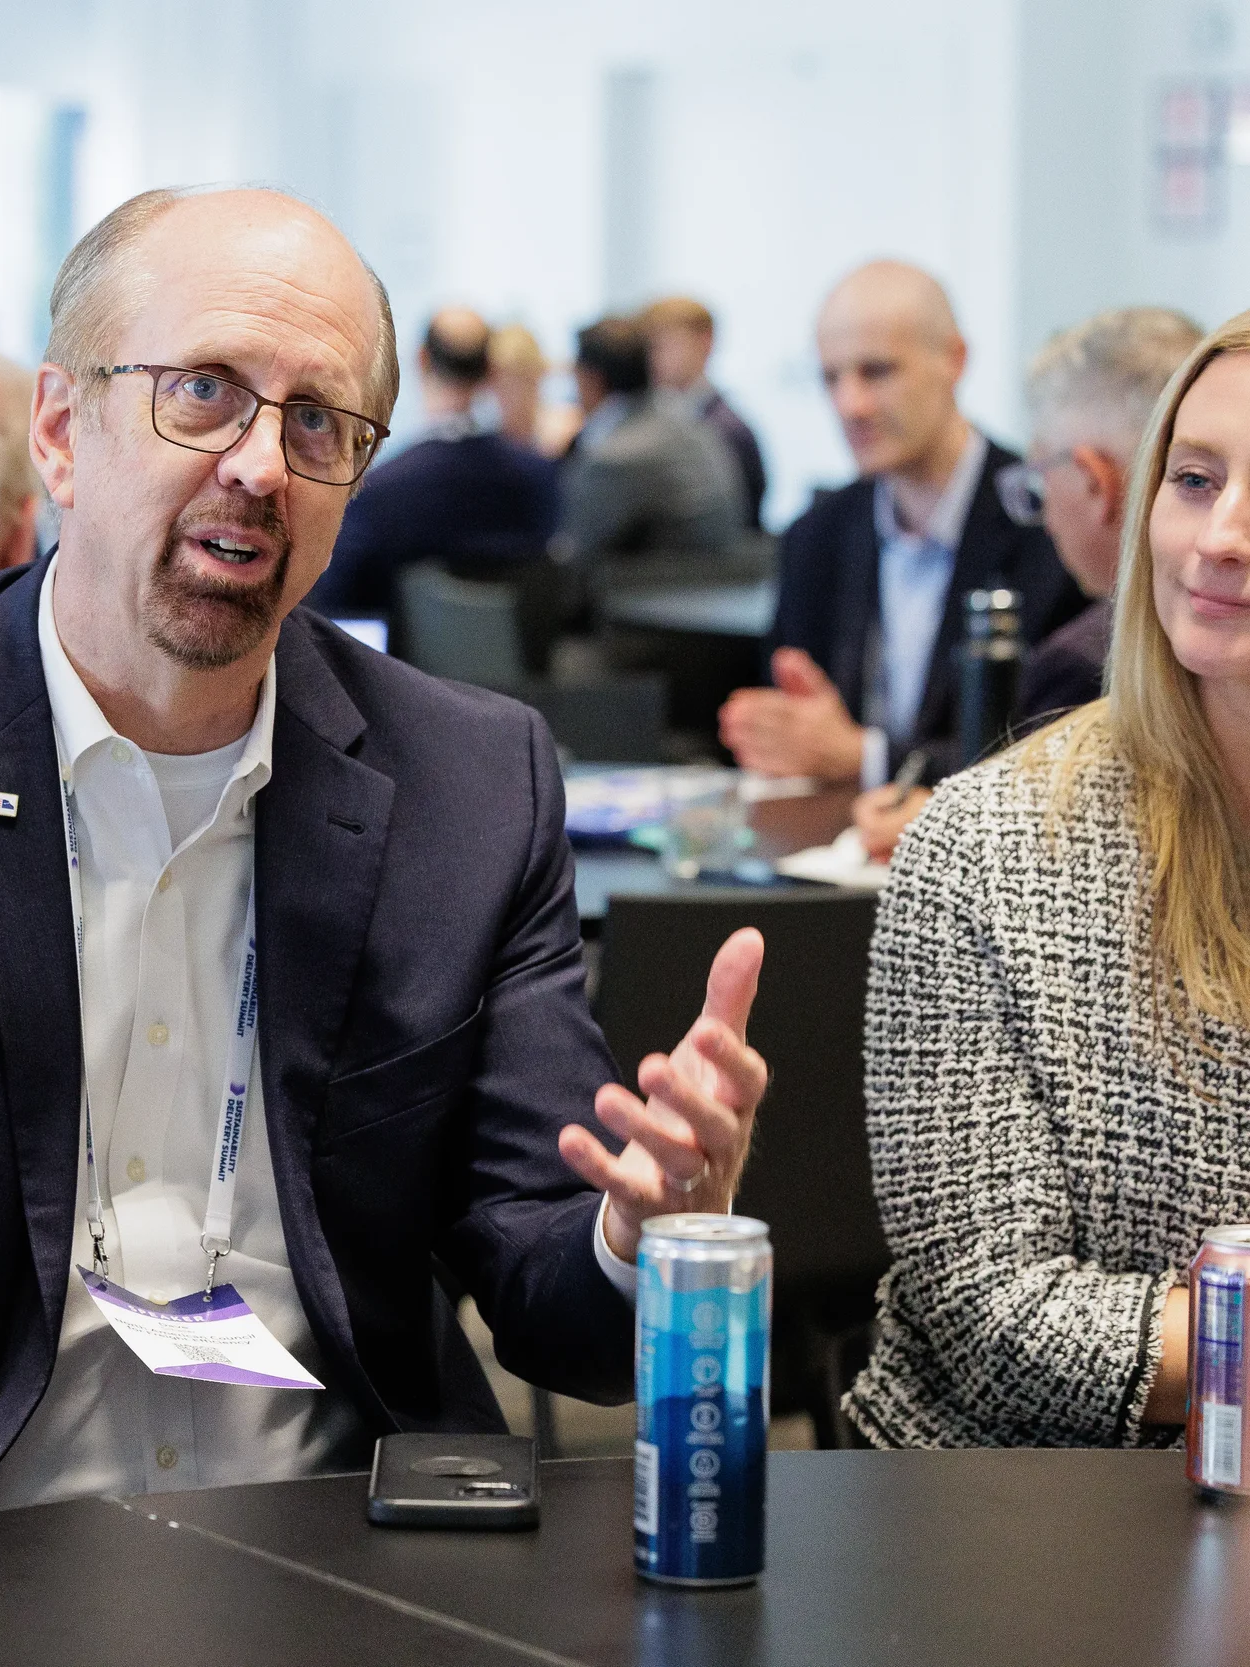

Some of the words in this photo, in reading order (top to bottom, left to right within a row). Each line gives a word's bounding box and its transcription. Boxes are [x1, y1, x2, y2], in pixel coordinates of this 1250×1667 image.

[242, 953, 254, 1000] DELIVERY
[237, 1000, 248, 1037] SUMMIT
[223, 1098, 235, 1144] DELIVERY
[228, 1100, 243, 1173] SUSTAINABILITY
[218, 1145, 230, 1182] SUMMIT
[127, 1304, 205, 1322] SPEAKER
[210, 1333, 256, 1341] Council
